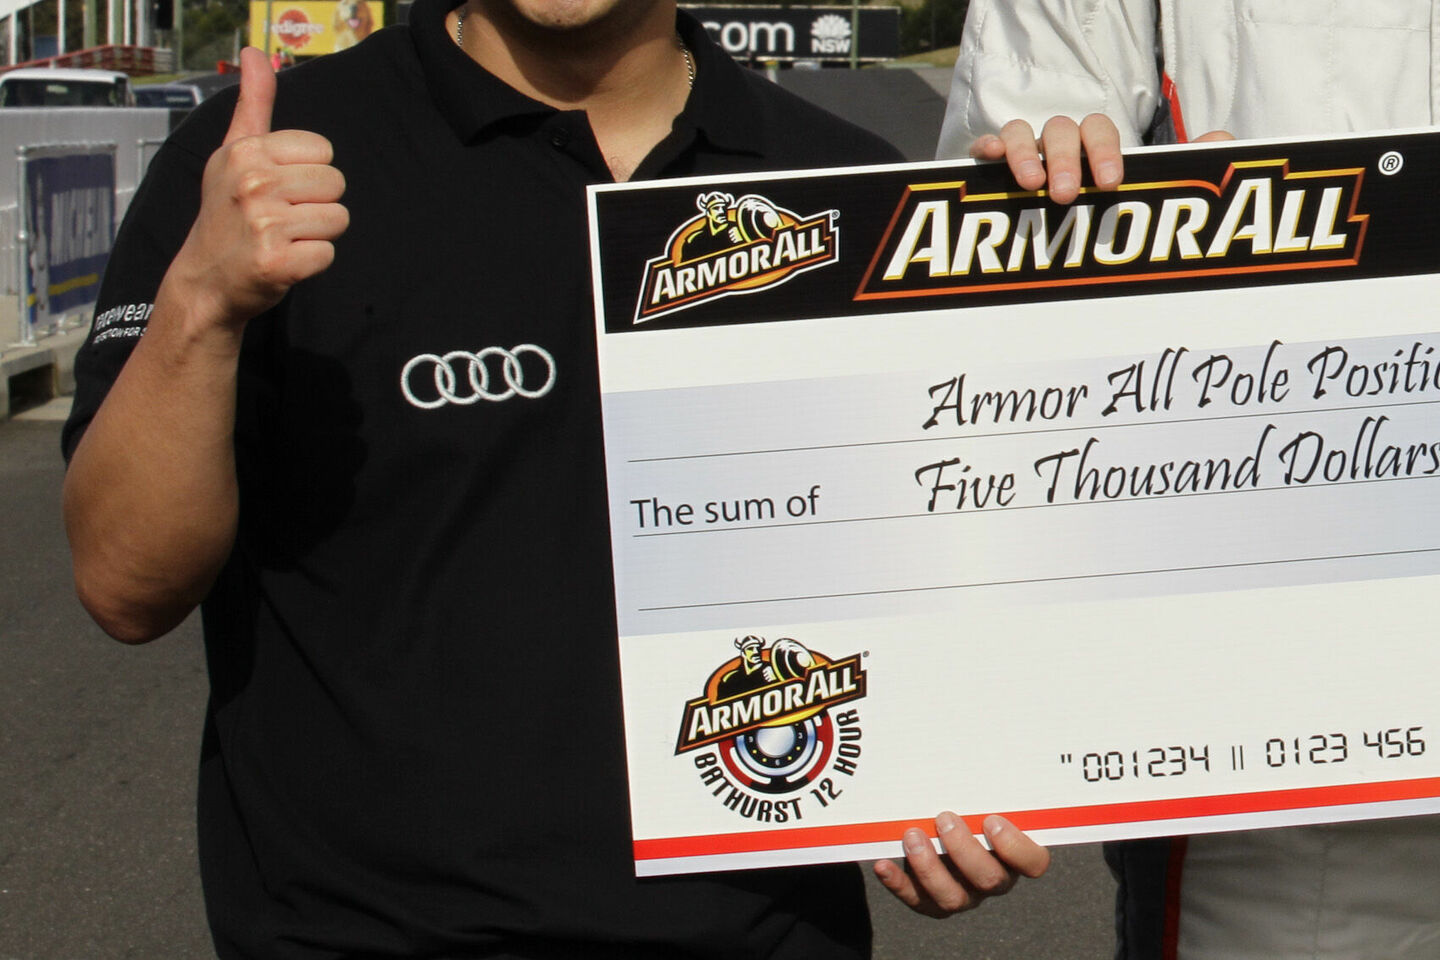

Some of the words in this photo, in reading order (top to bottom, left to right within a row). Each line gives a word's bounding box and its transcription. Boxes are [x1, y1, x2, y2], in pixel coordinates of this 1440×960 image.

[811, 38, 851, 54] NSW
[922, 374, 1088, 430] Armor
[1102, 347, 1189, 417] All
[1192, 340, 1289, 408] Pole
[915, 458, 1015, 512] Five
[1034, 421, 1276, 503] Thousand
[630, 498, 693, 527] The
[705, 498, 774, 523] sum
[787, 485, 820, 517] of
[694, 751, 803, 823] BATHURST
[810, 777, 843, 808] 12
[833, 708, 863, 776] HOUR
[1266, 734, 1347, 767] 0123
[1364, 727, 1425, 758] 456
